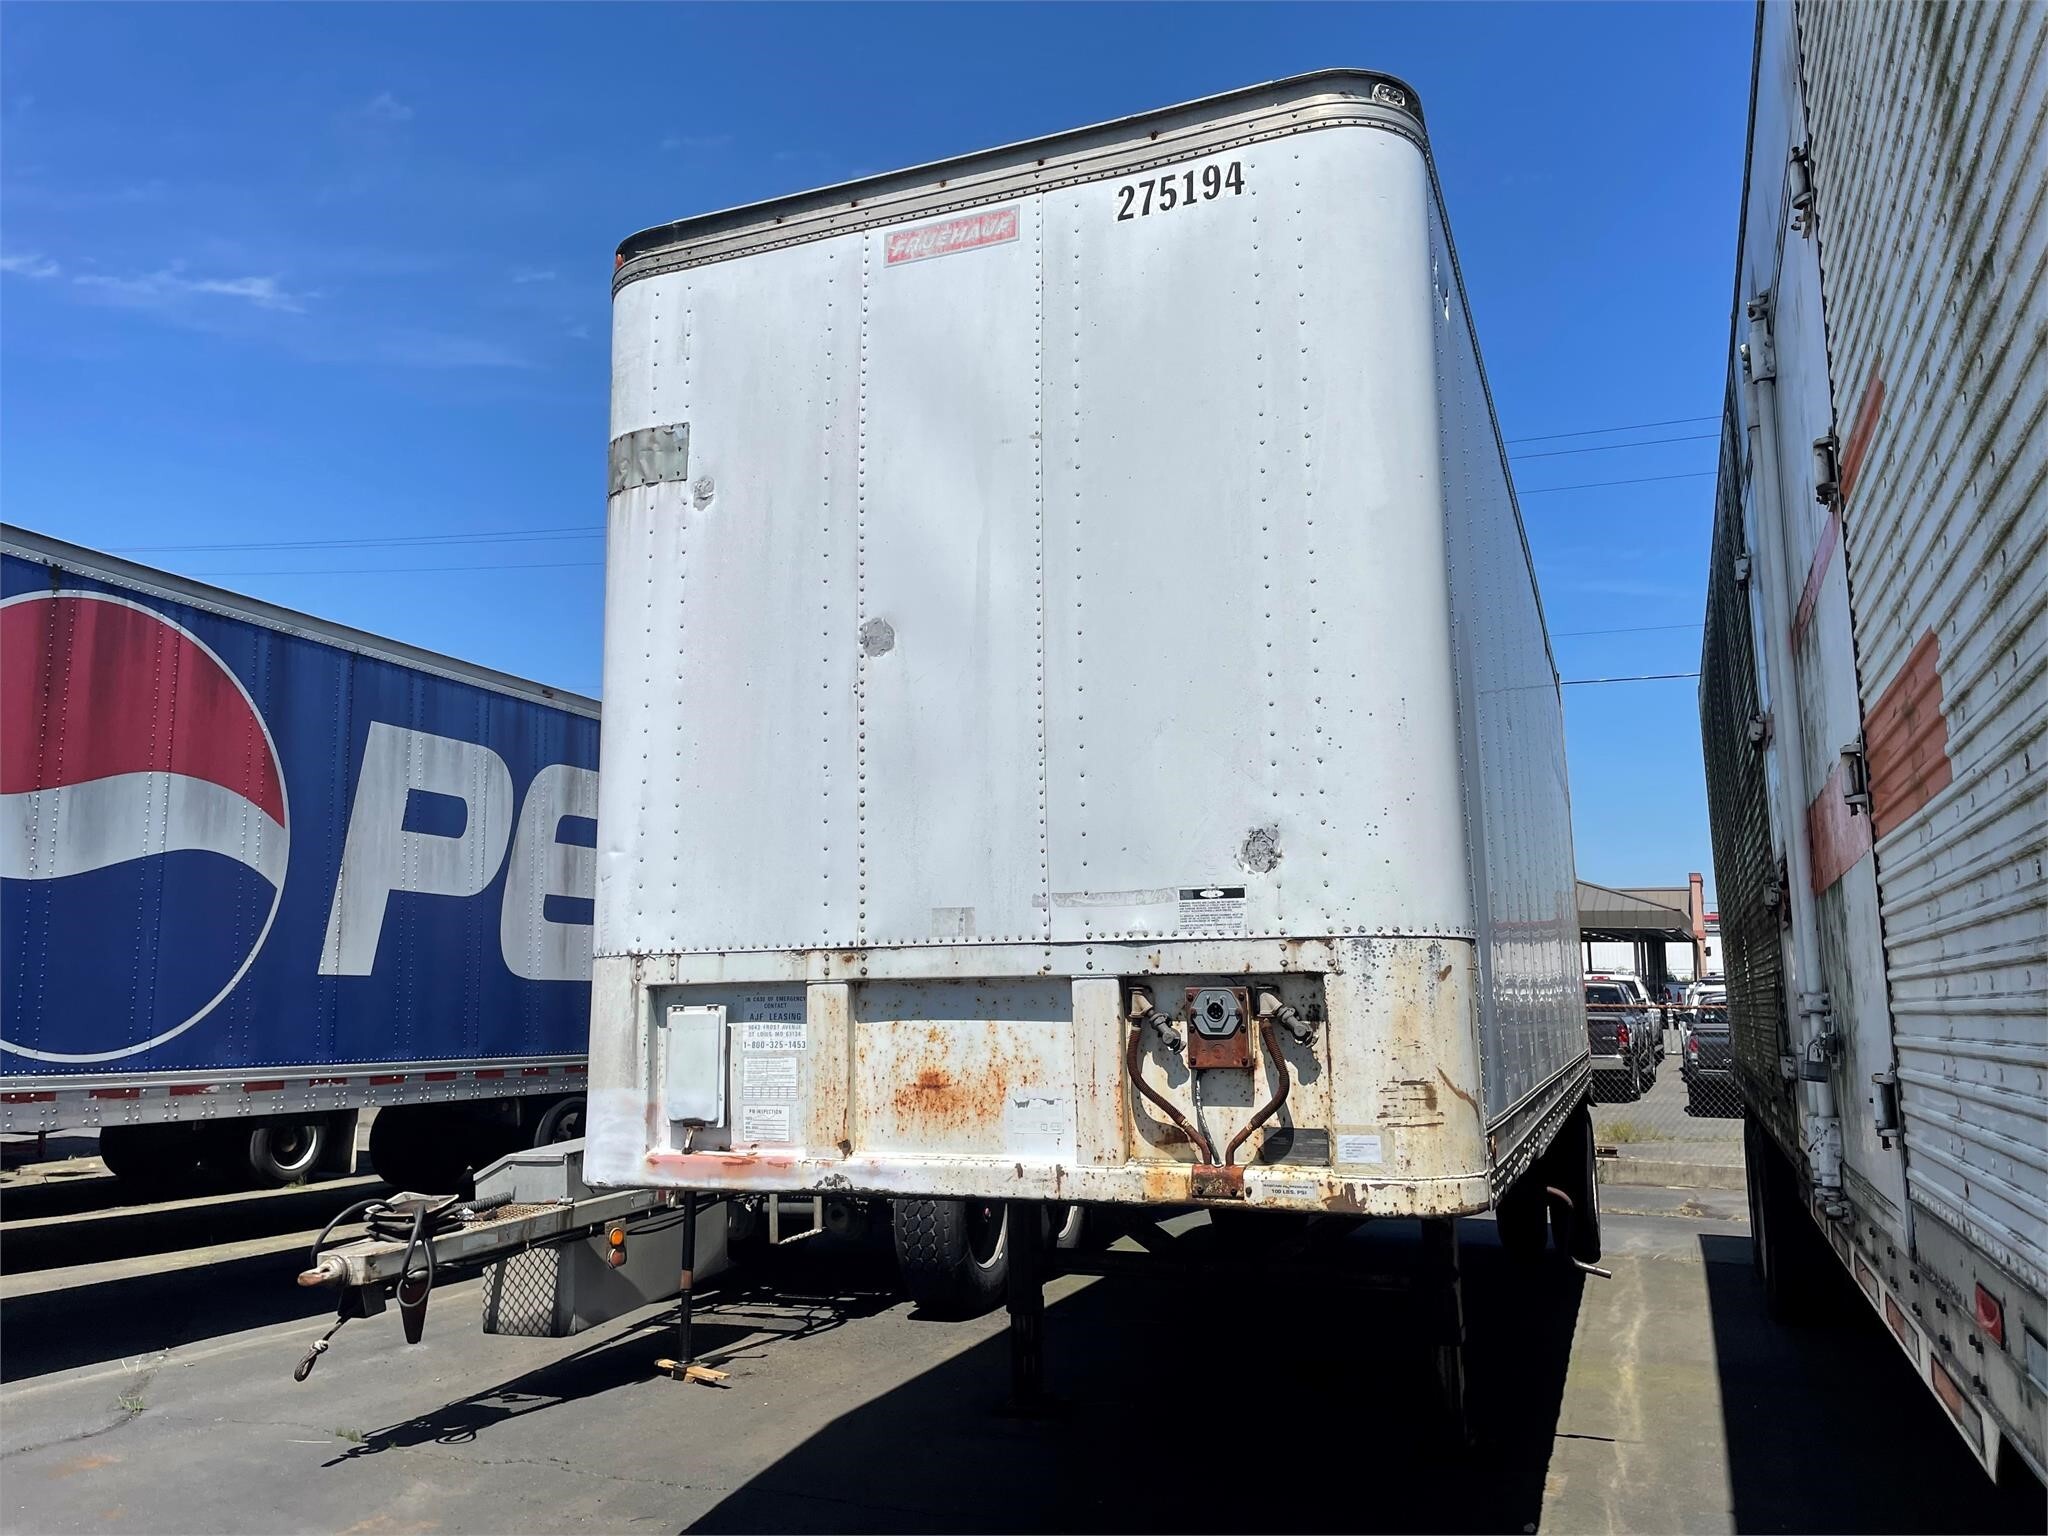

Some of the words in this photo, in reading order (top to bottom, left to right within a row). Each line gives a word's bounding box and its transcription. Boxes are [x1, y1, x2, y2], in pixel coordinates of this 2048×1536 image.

[1117, 161, 1245, 221] 275194
[769, 1013, 801, 1021] LEASING
[743, 1041, 806, 1049] 1-800-325-1453
